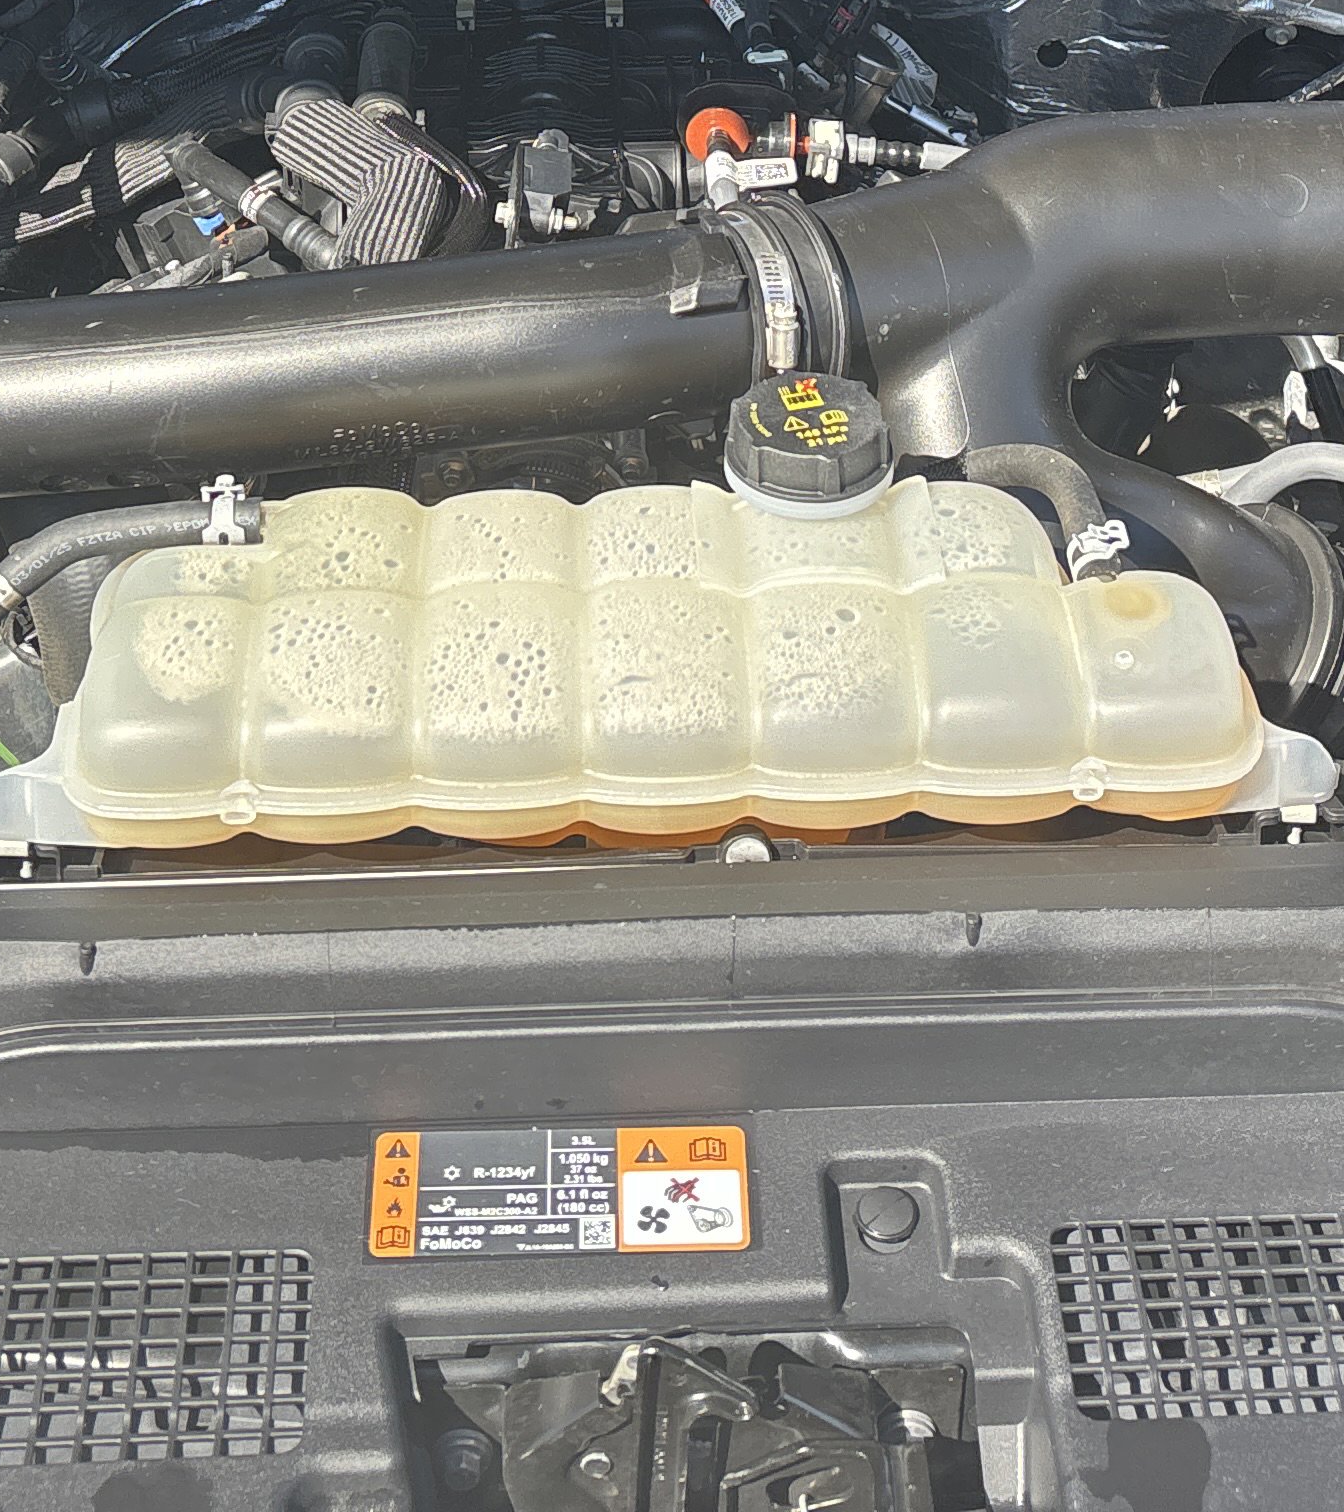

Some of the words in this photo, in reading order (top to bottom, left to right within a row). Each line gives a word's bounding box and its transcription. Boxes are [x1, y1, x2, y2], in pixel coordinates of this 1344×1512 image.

[796, 429, 821, 439] 140
[807, 438, 824, 448] 21
[827, 434, 848, 445] psi
[129, 525, 156, 537] CIP
[558, 1153, 590, 1164] 1.050
[593, 1153, 609, 1166] kg
[473, 1166, 536, 1180] R-1234yf
[570, 1165, 582, 1174] 37
[564, 1175, 584, 1184] 2.31
[587, 1175, 603, 1184] lbs
[506, 1192, 538, 1205] PAG
[556, 1189, 576, 1200] 6.1
[579, 1189, 589, 1200] fl
[591, 1190, 609, 1199] oz
[557, 1202, 586, 1215] (180
[589, 1202, 609, 1214] cc)
[421, 1226, 449, 1236] SAE
[419, 1237, 482, 1251] FoMoCo
